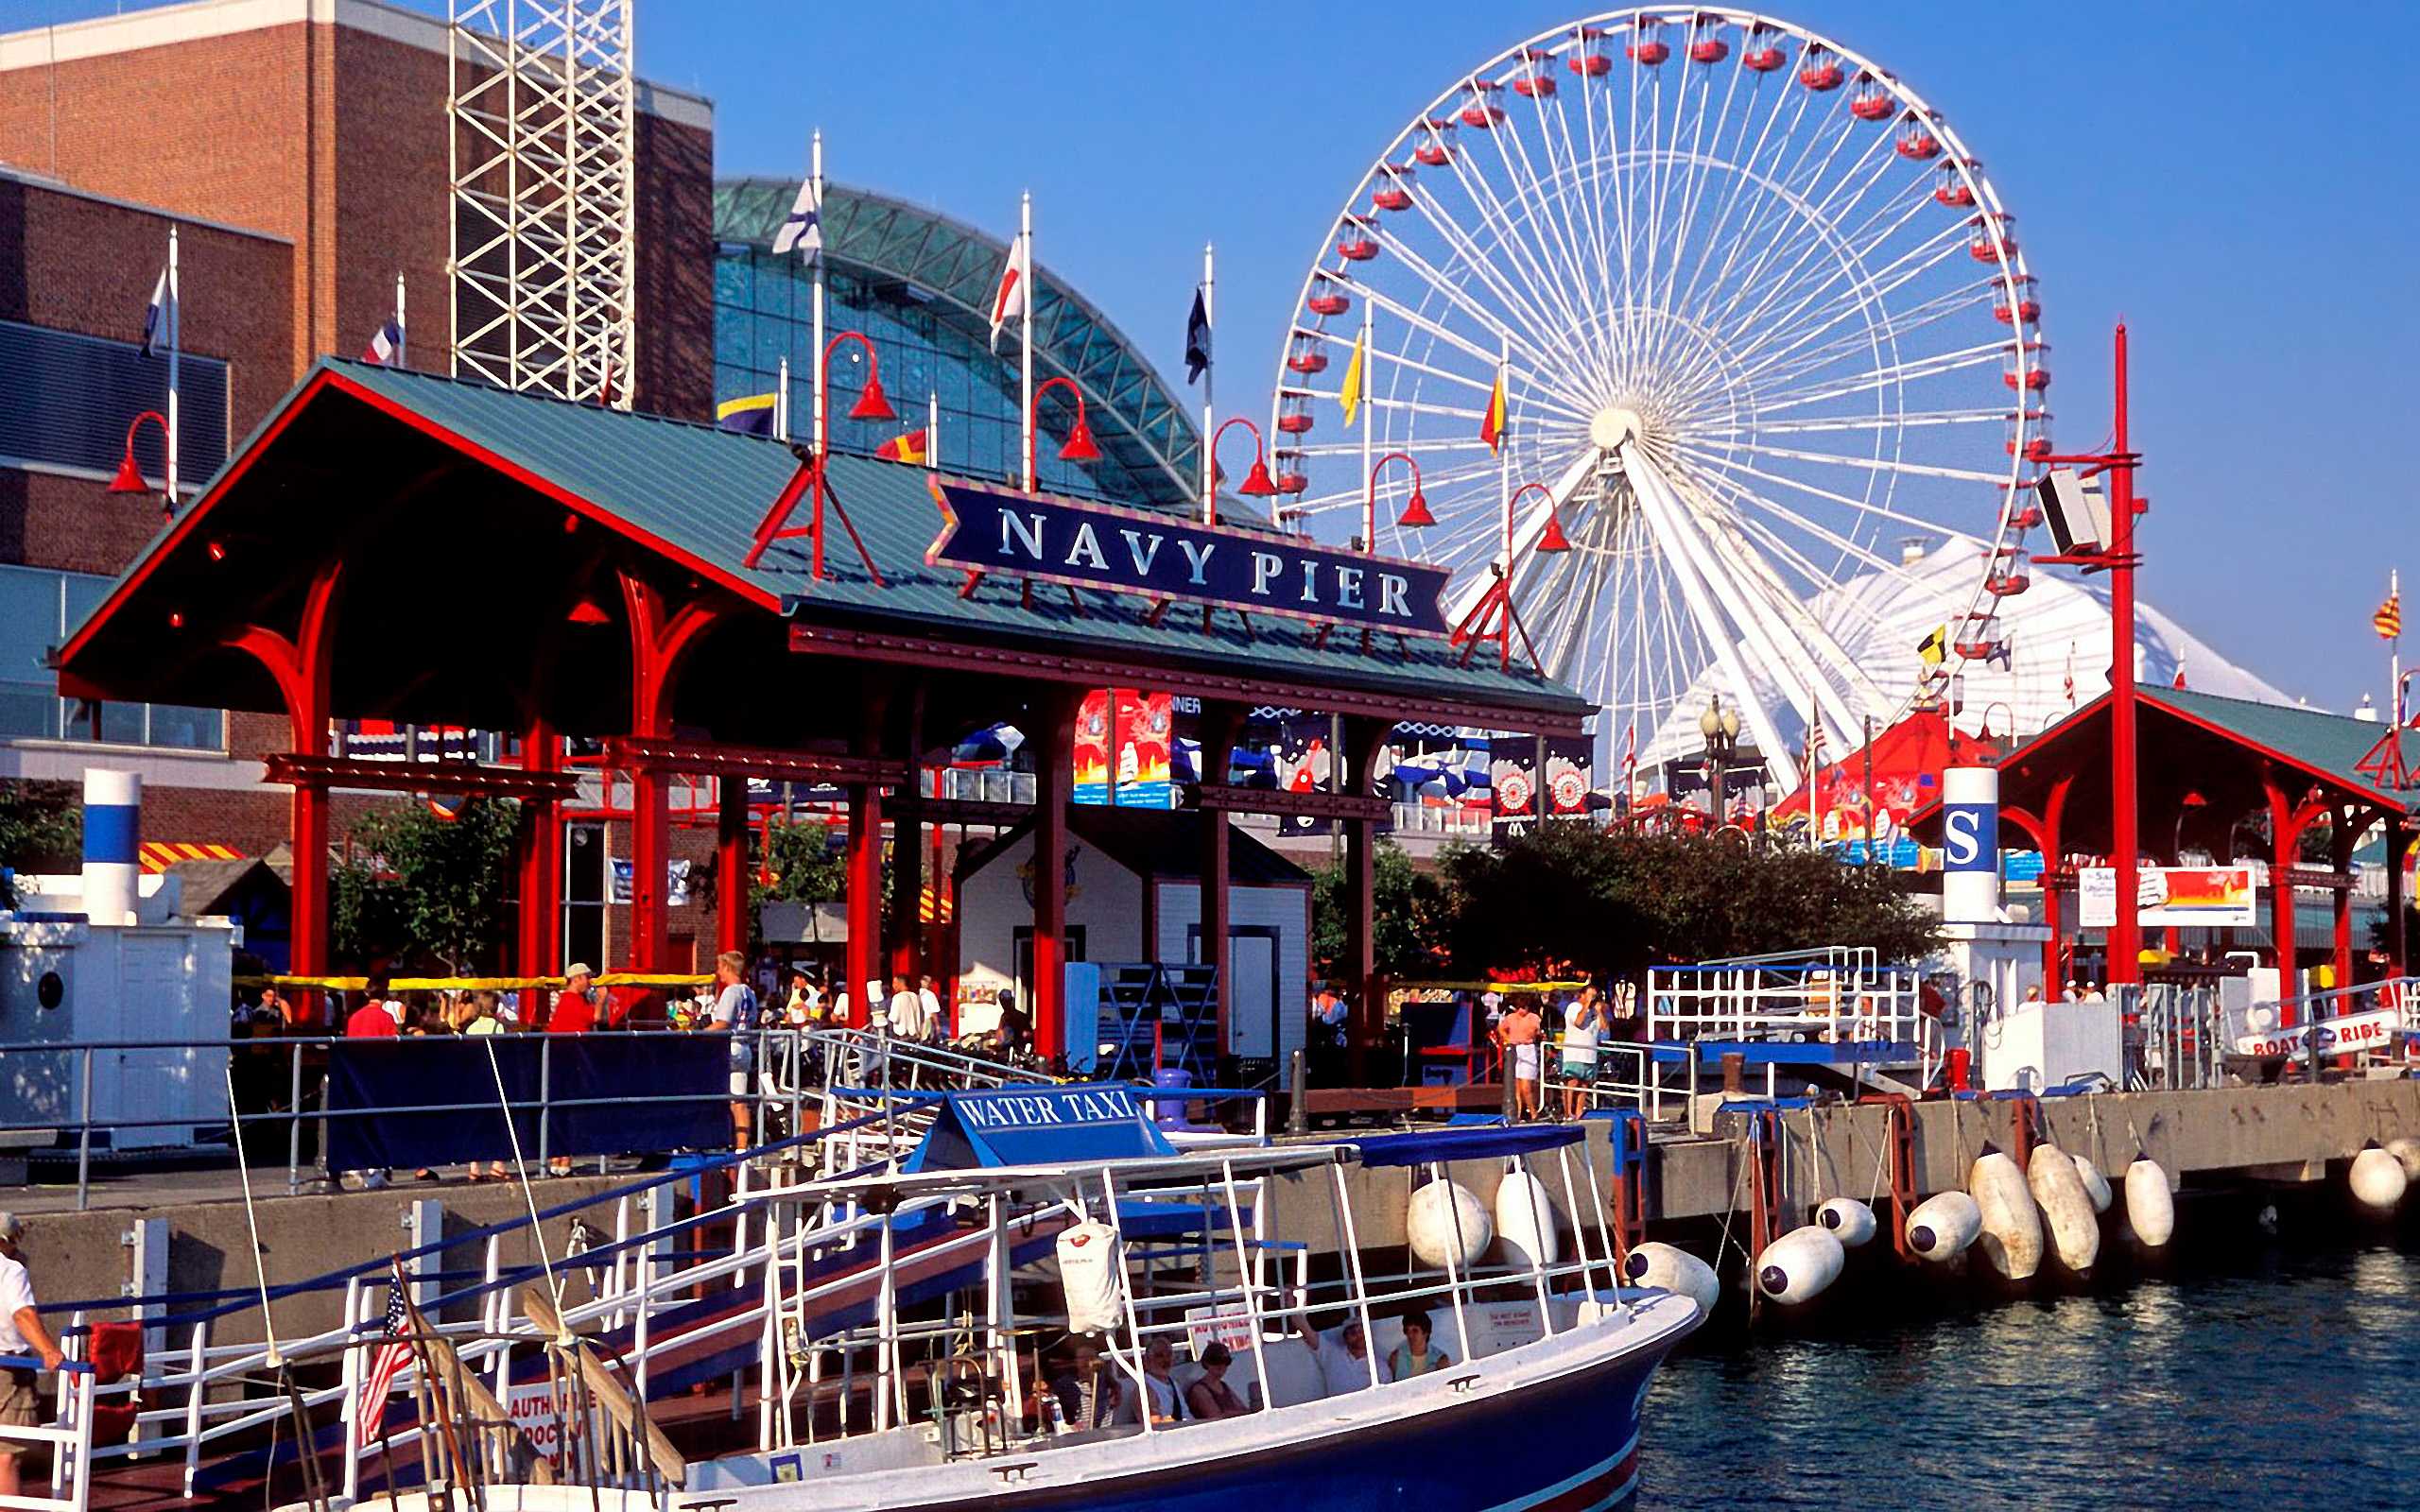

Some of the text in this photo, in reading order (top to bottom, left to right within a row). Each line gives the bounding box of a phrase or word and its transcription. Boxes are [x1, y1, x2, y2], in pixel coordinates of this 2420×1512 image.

[998, 507, 1413, 617] NAVY PIER
[1945, 810, 1979, 865] S
[2253, 1022, 2383, 1056] BOAT RIDE
[958, 1091, 1135, 1127] WATER TAXI
